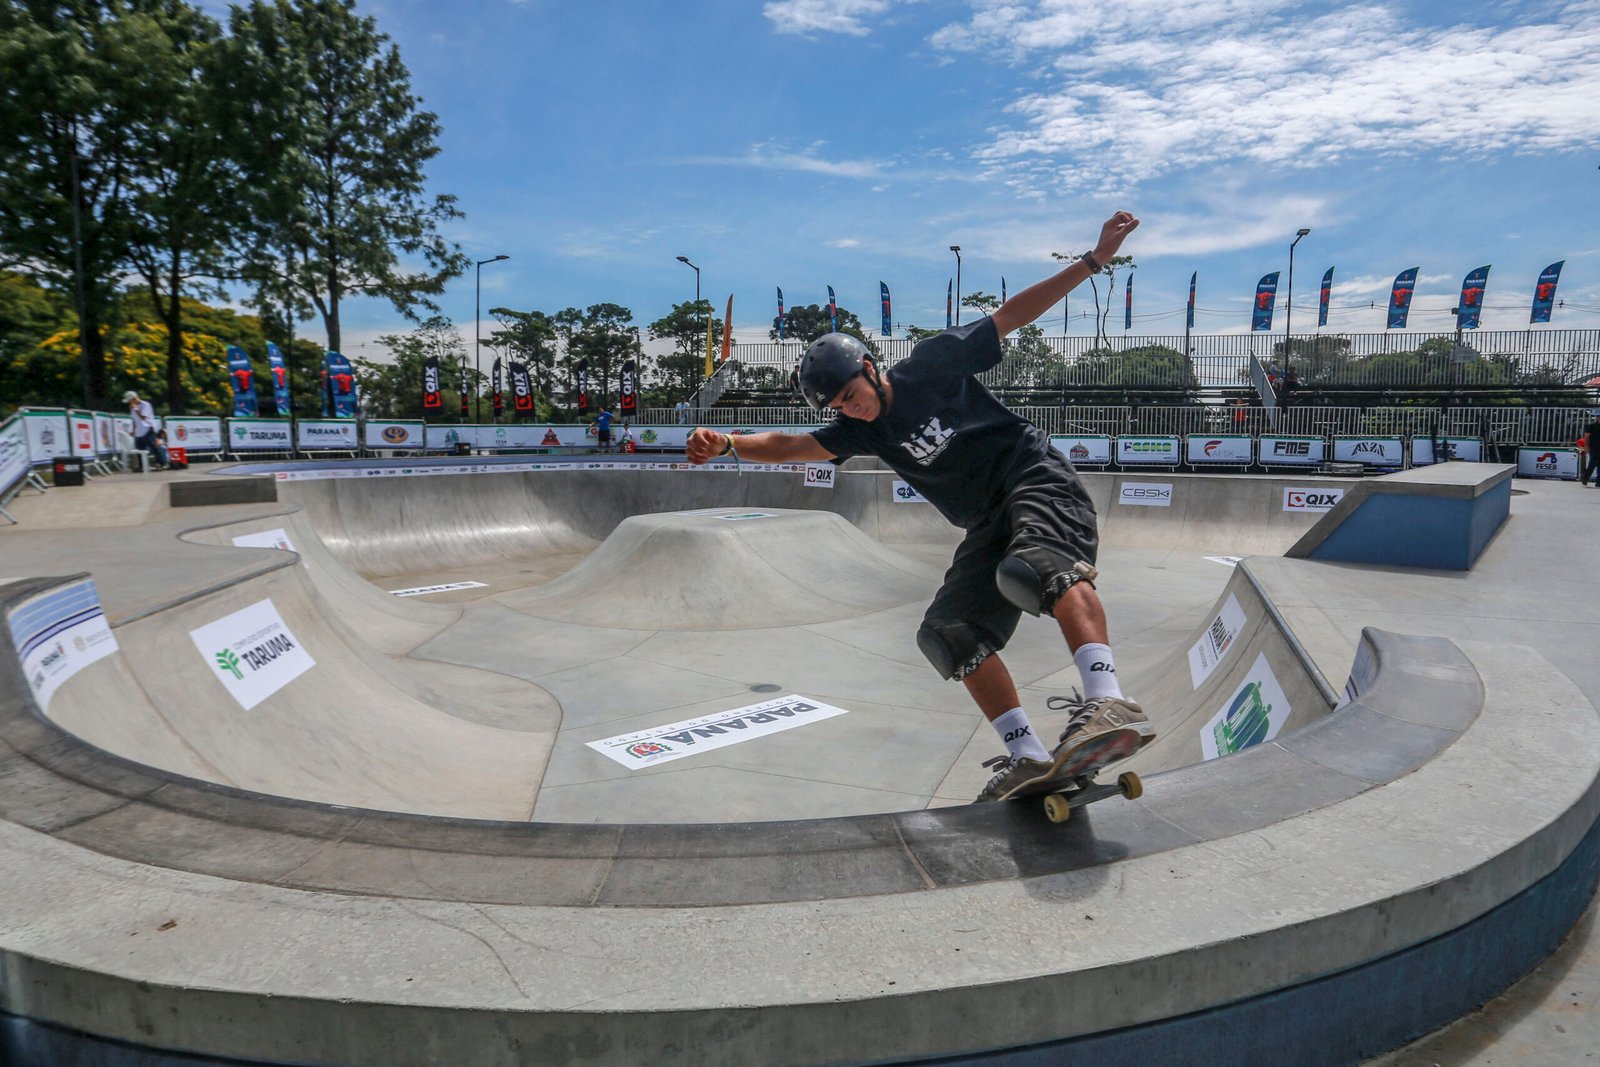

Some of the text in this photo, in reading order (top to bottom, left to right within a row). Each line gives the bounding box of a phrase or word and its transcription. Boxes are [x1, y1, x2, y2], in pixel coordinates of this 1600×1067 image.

[425, 366, 436, 393] QIX
[513, 371, 527, 397] QIX
[622, 370, 632, 395] QIX
[1273, 441, 1311, 454] FMS
[816, 469, 833, 480] QIX
[1122, 488, 1170, 498] CBSK
[1305, 494, 1338, 505] QIX
[661, 702, 820, 746] PARANÁ
[1004, 725, 1032, 743] QIX
